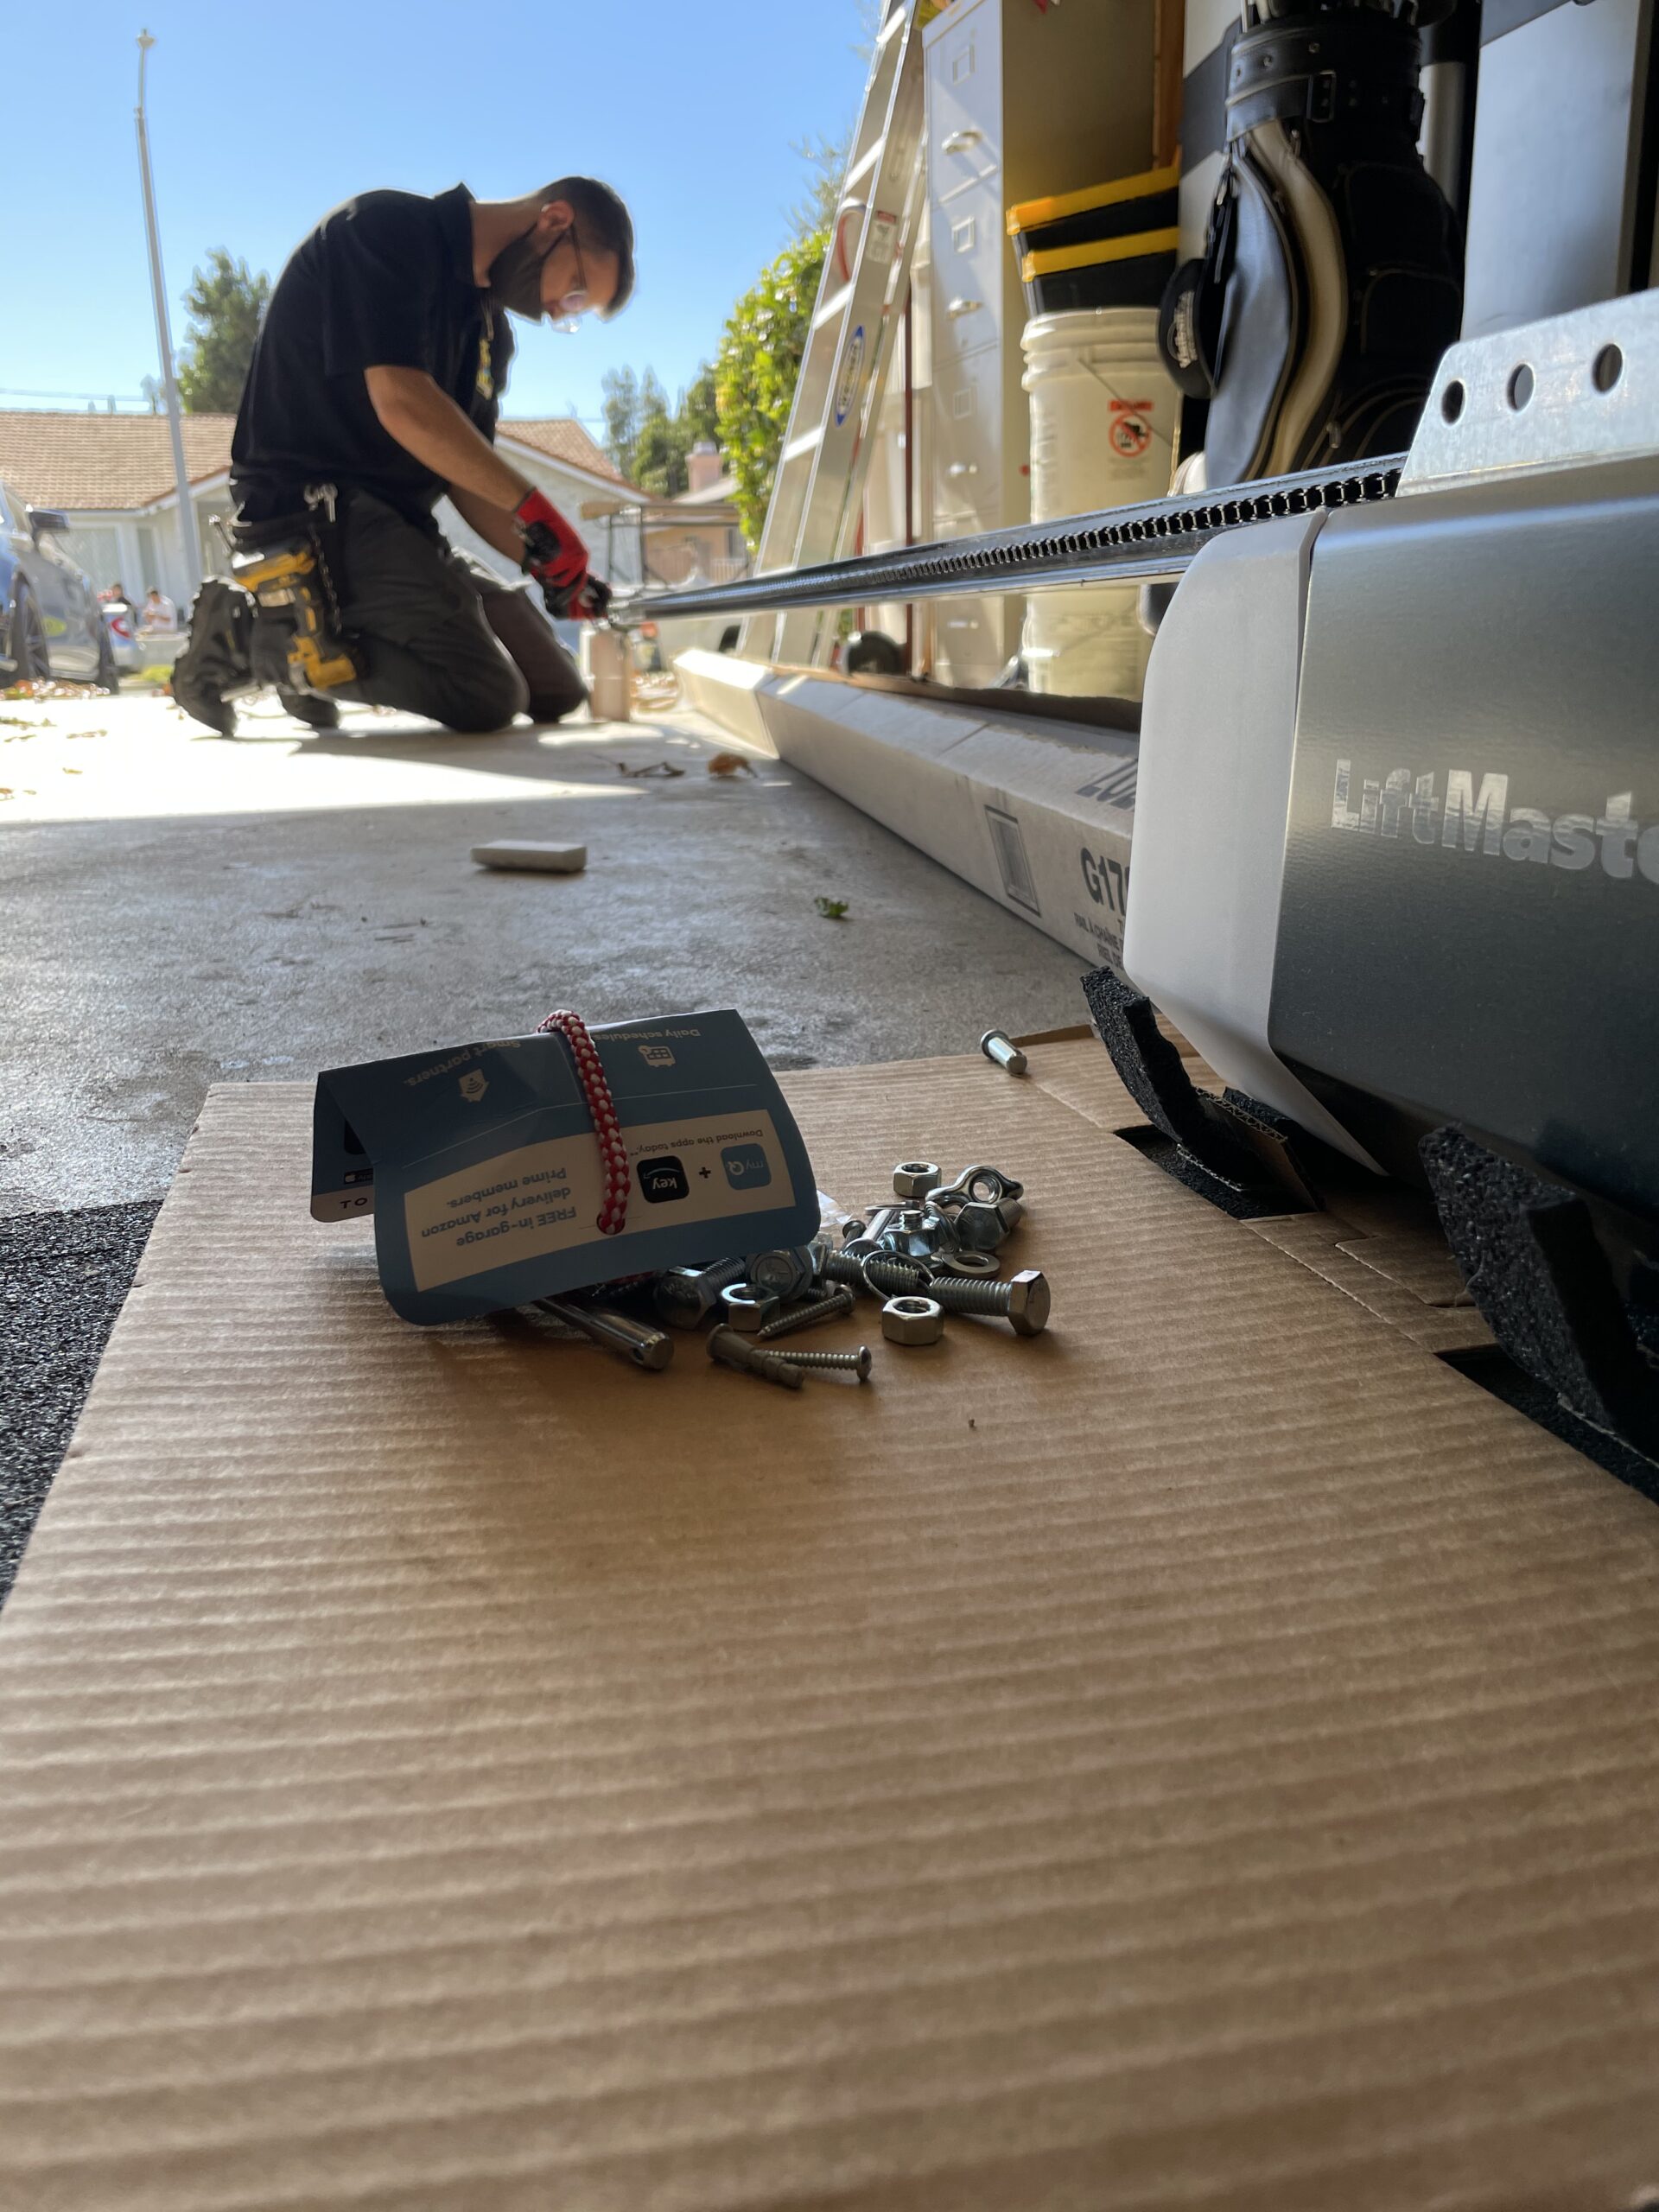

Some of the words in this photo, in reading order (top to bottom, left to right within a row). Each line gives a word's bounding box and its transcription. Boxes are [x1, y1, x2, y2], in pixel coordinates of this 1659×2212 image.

[1080, 848, 1129, 917] G17
[665, 1028, 701, 1039] Daily
[473, 1039, 521, 1057] Smart
[403, 1050, 471, 1086] partners.
[671, 1138, 695, 1147] apps
[716, 1129, 763, 1143] Download
[522, 1168, 567, 1185] Prime
[728, 1160, 764, 1176] myQ
[652, 1177, 677, 1190] key
[446, 1179, 518, 1208] members.
[512, 1186, 571, 1210] delivery
[486, 1203, 509, 1217] for
[537, 1206, 577, 1227] FREE
[421, 1211, 481, 1237] Amazon
[456, 1217, 534, 1246] in-garage
